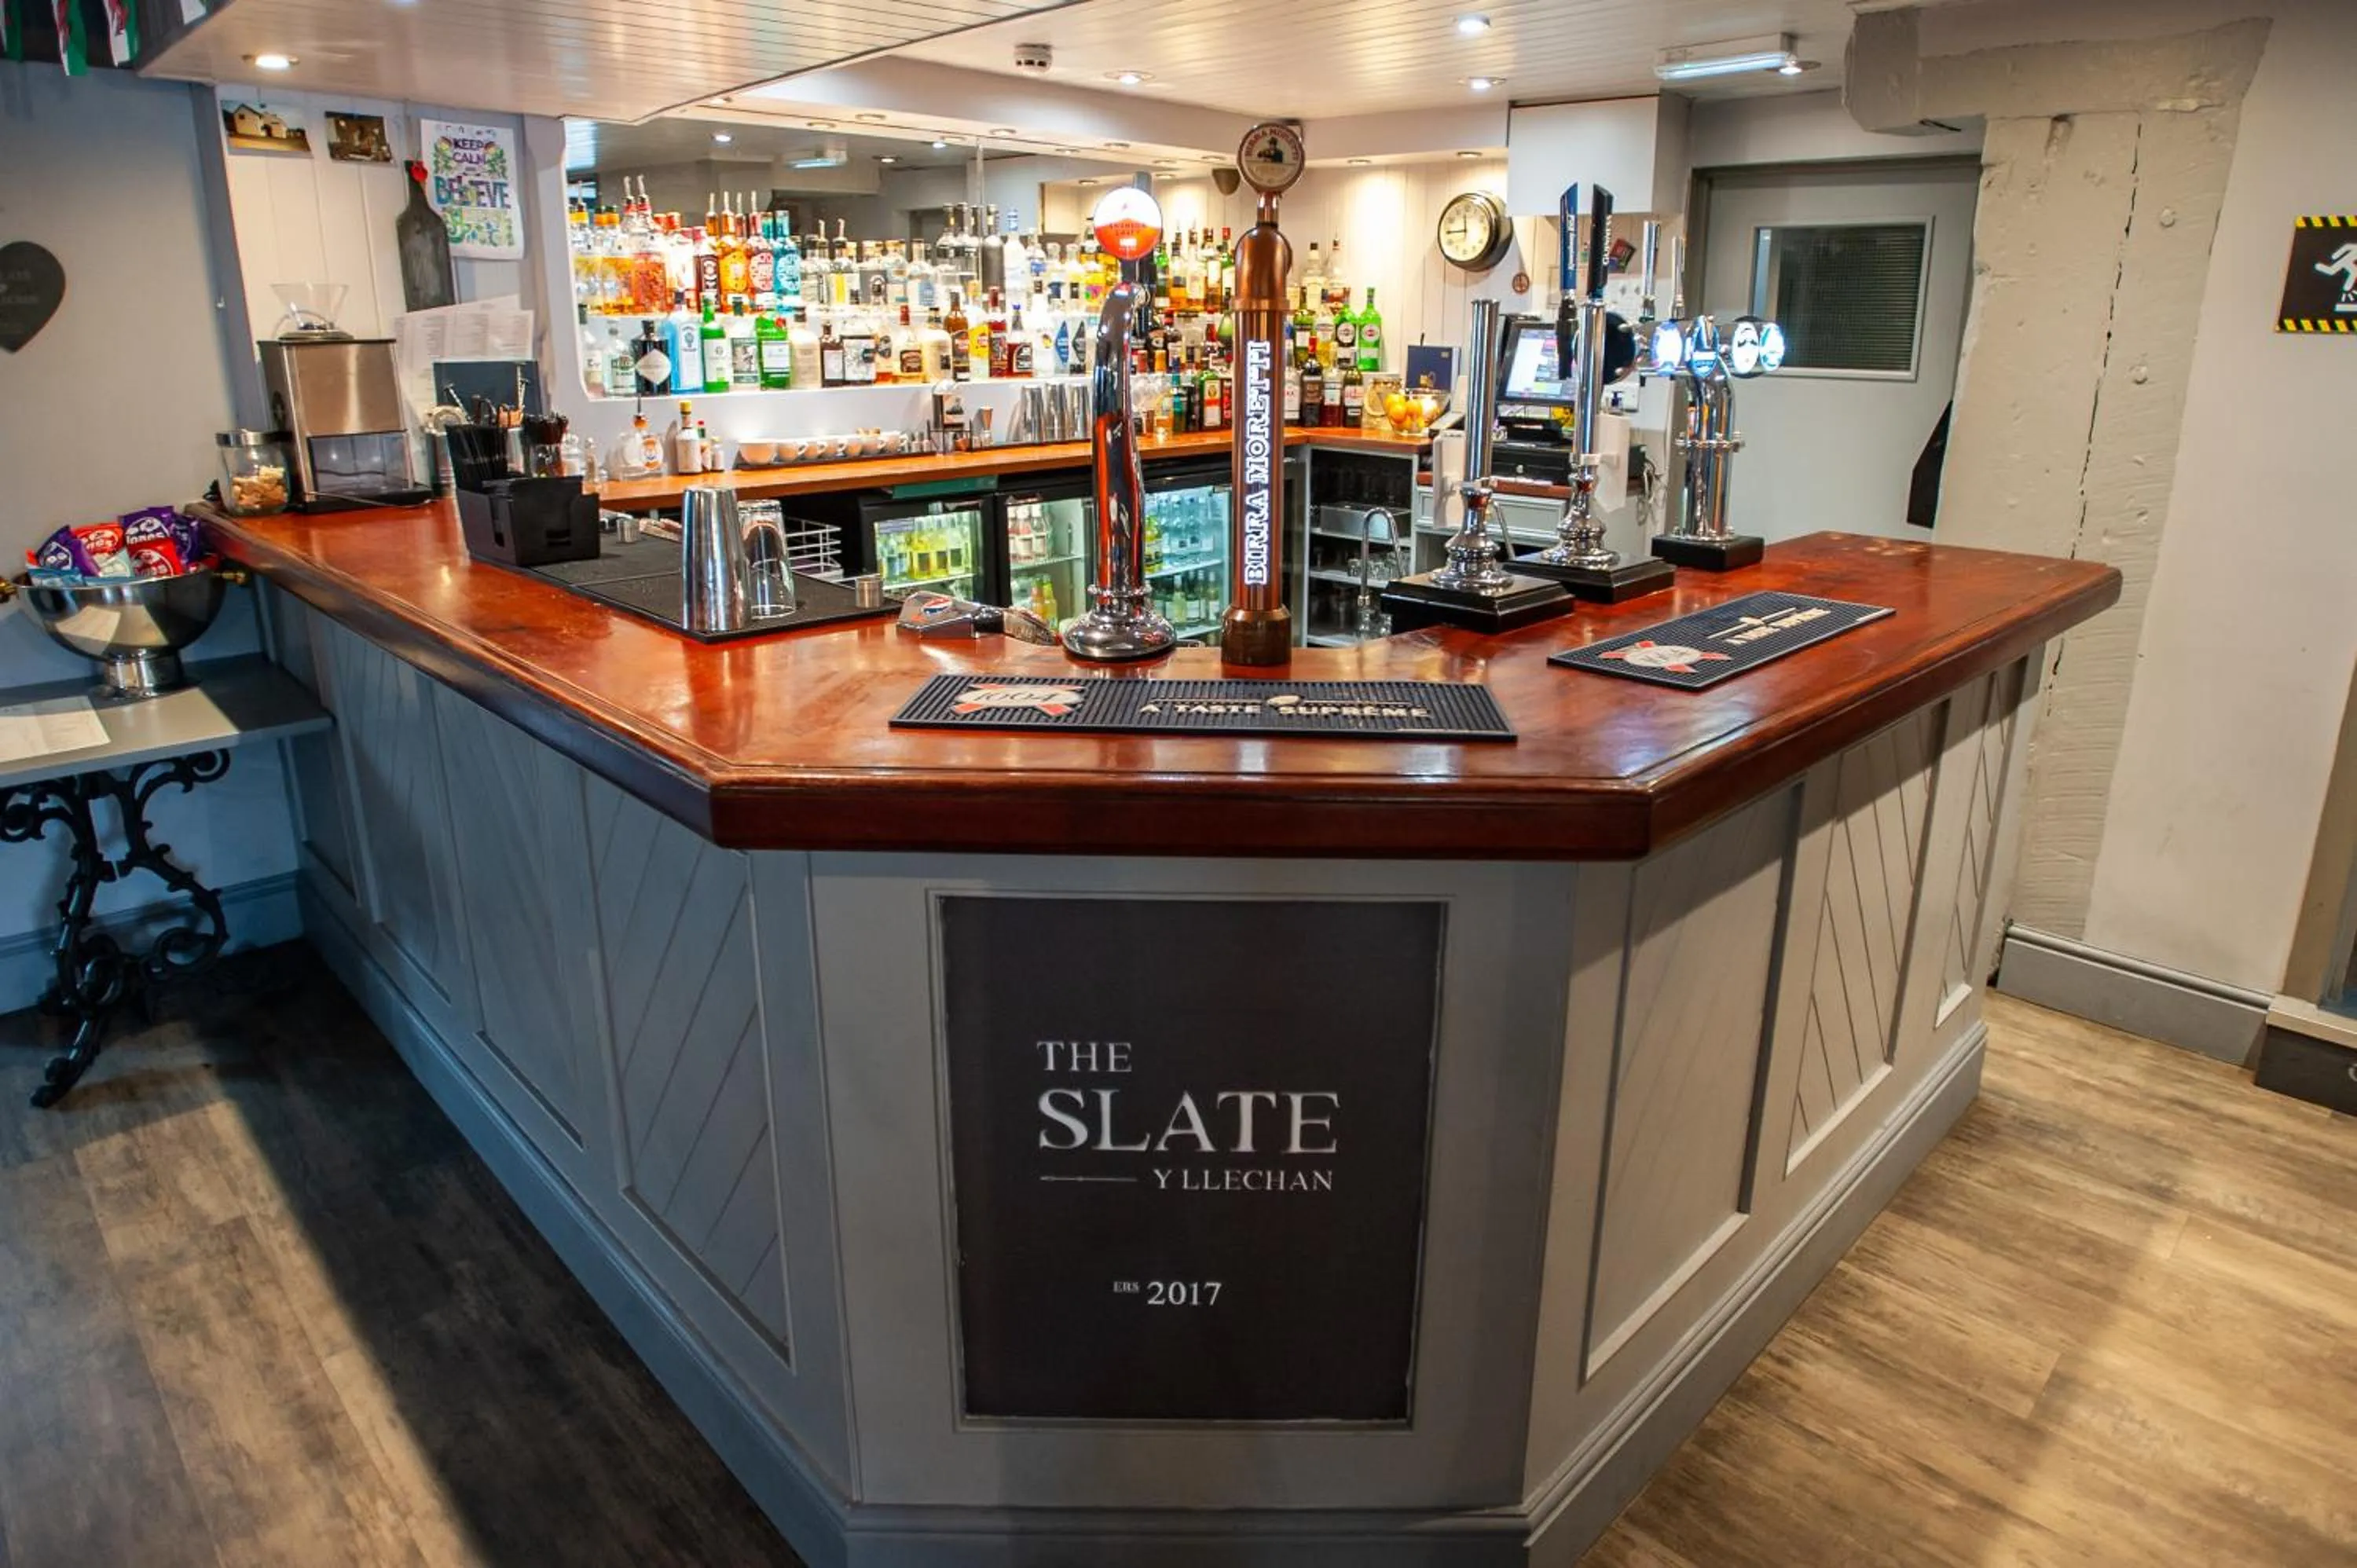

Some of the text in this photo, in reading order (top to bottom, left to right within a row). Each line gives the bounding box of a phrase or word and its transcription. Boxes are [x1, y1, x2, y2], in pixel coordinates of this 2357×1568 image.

[453, 137, 484, 151] KEEP
[453, 152, 486, 165] CALM
[1244, 340, 1270, 585] BIRRA MORETTI
[1140, 704, 1161, 713] A
[1175, 705, 1260, 714] TASTE
[1036, 1041, 1132, 1072] THE
[1038, 1087, 1340, 1154] SLATE
[1153, 1168, 1333, 1191] Y LLECHAN
[1147, 1280, 1222, 1306] 2017
